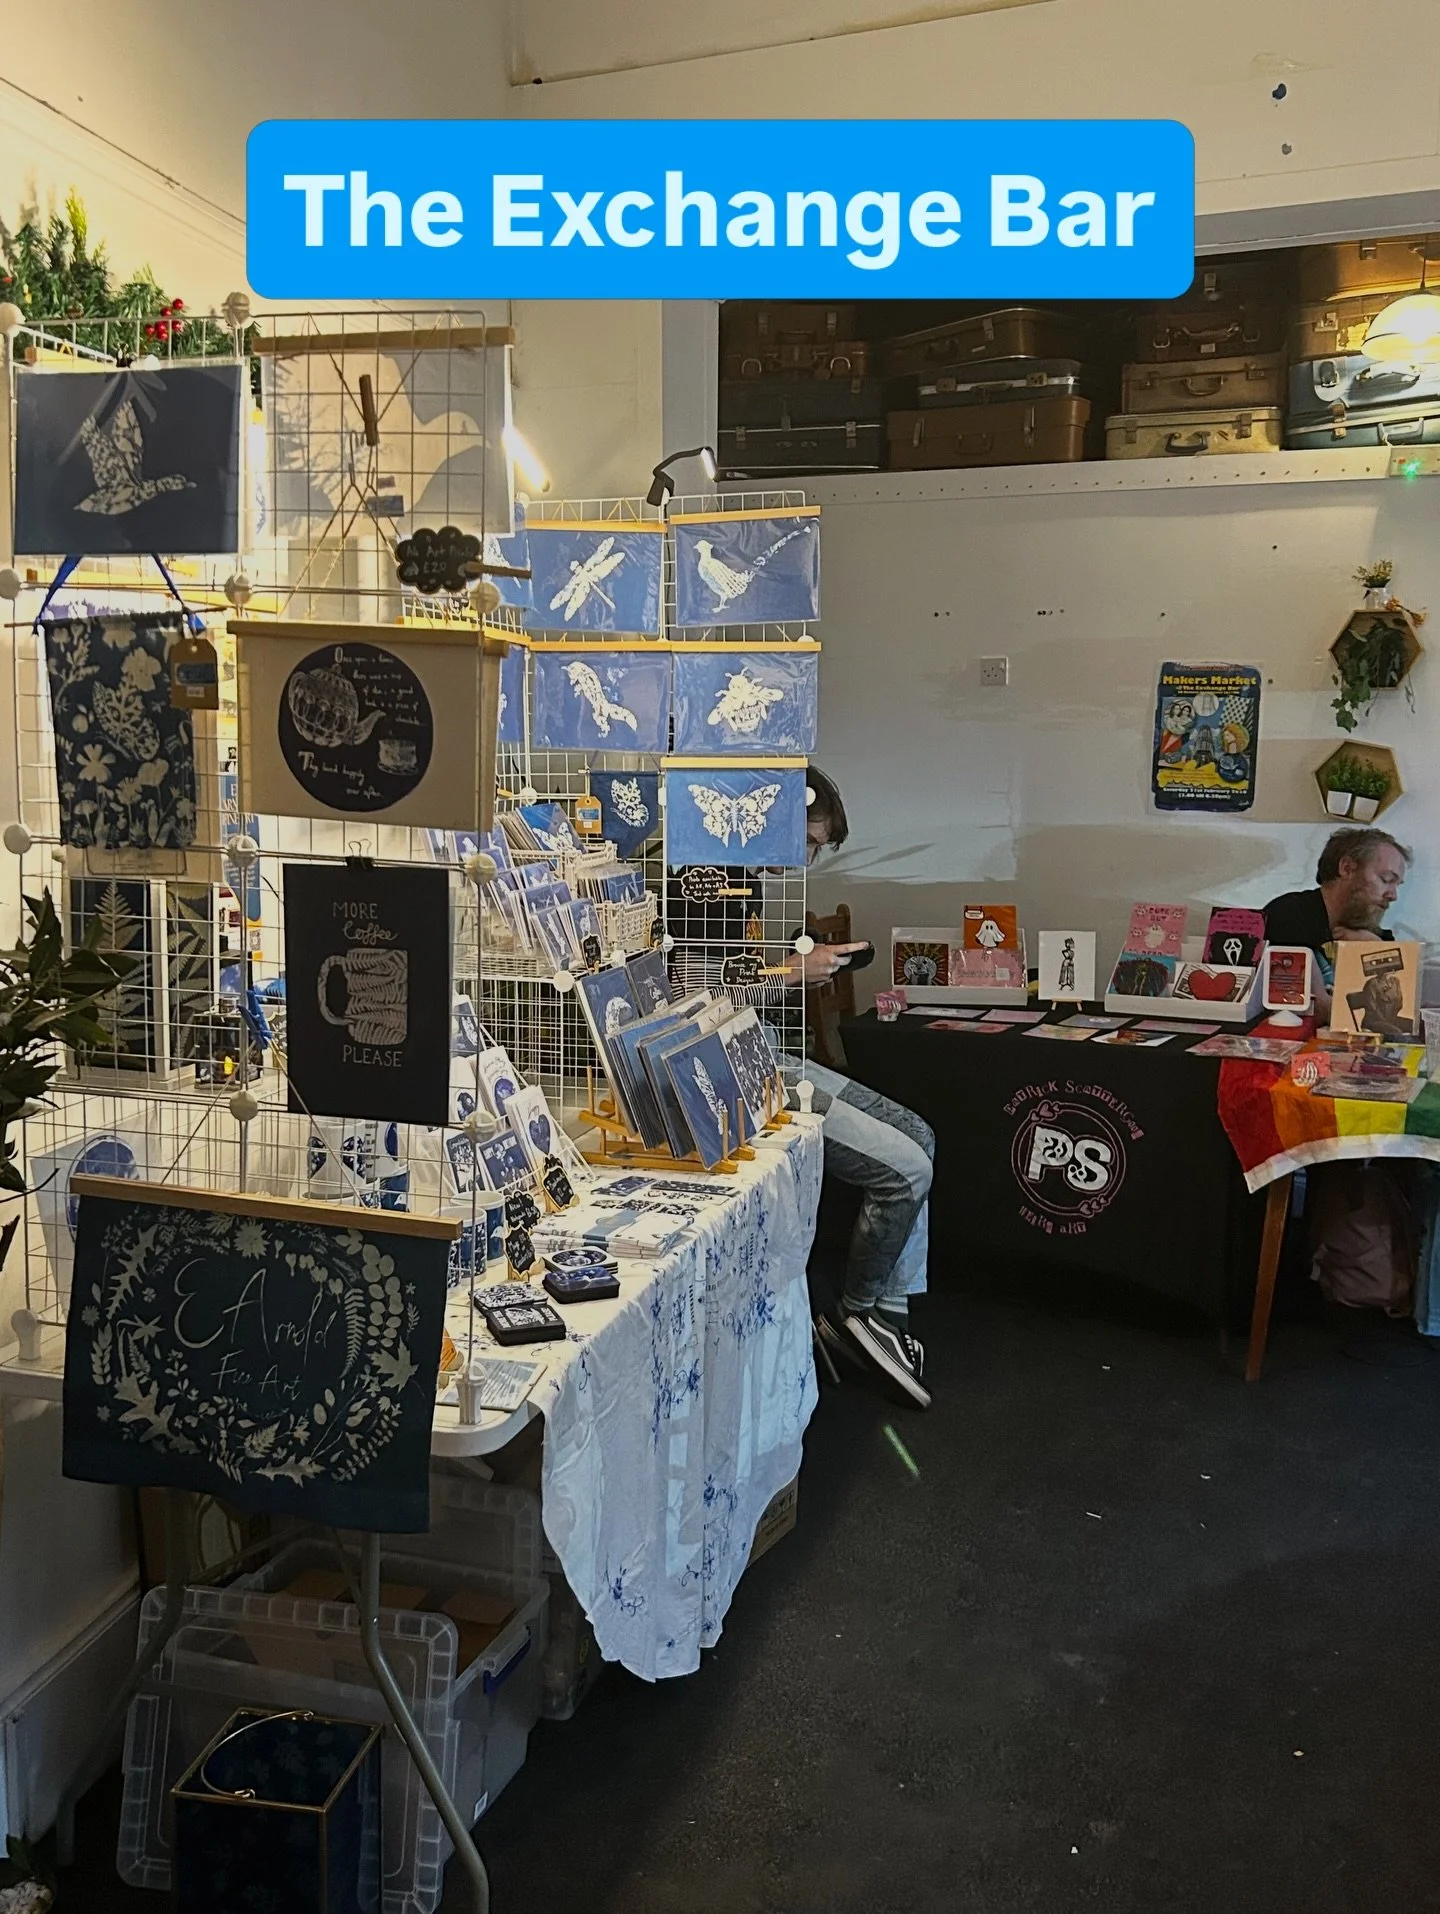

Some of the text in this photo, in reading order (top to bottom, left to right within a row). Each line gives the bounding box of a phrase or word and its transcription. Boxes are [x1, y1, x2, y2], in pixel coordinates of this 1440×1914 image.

[1162, 675, 1257, 686] Makers Market
[332, 901, 379, 920] MORE
[343, 920, 399, 946] Coffee
[343, 1044, 404, 1068] PLEASE
[1027, 1124, 1112, 1192] PS
[174, 1258, 338, 1366] E Arnold
[258, 1364, 303, 1401] Art
